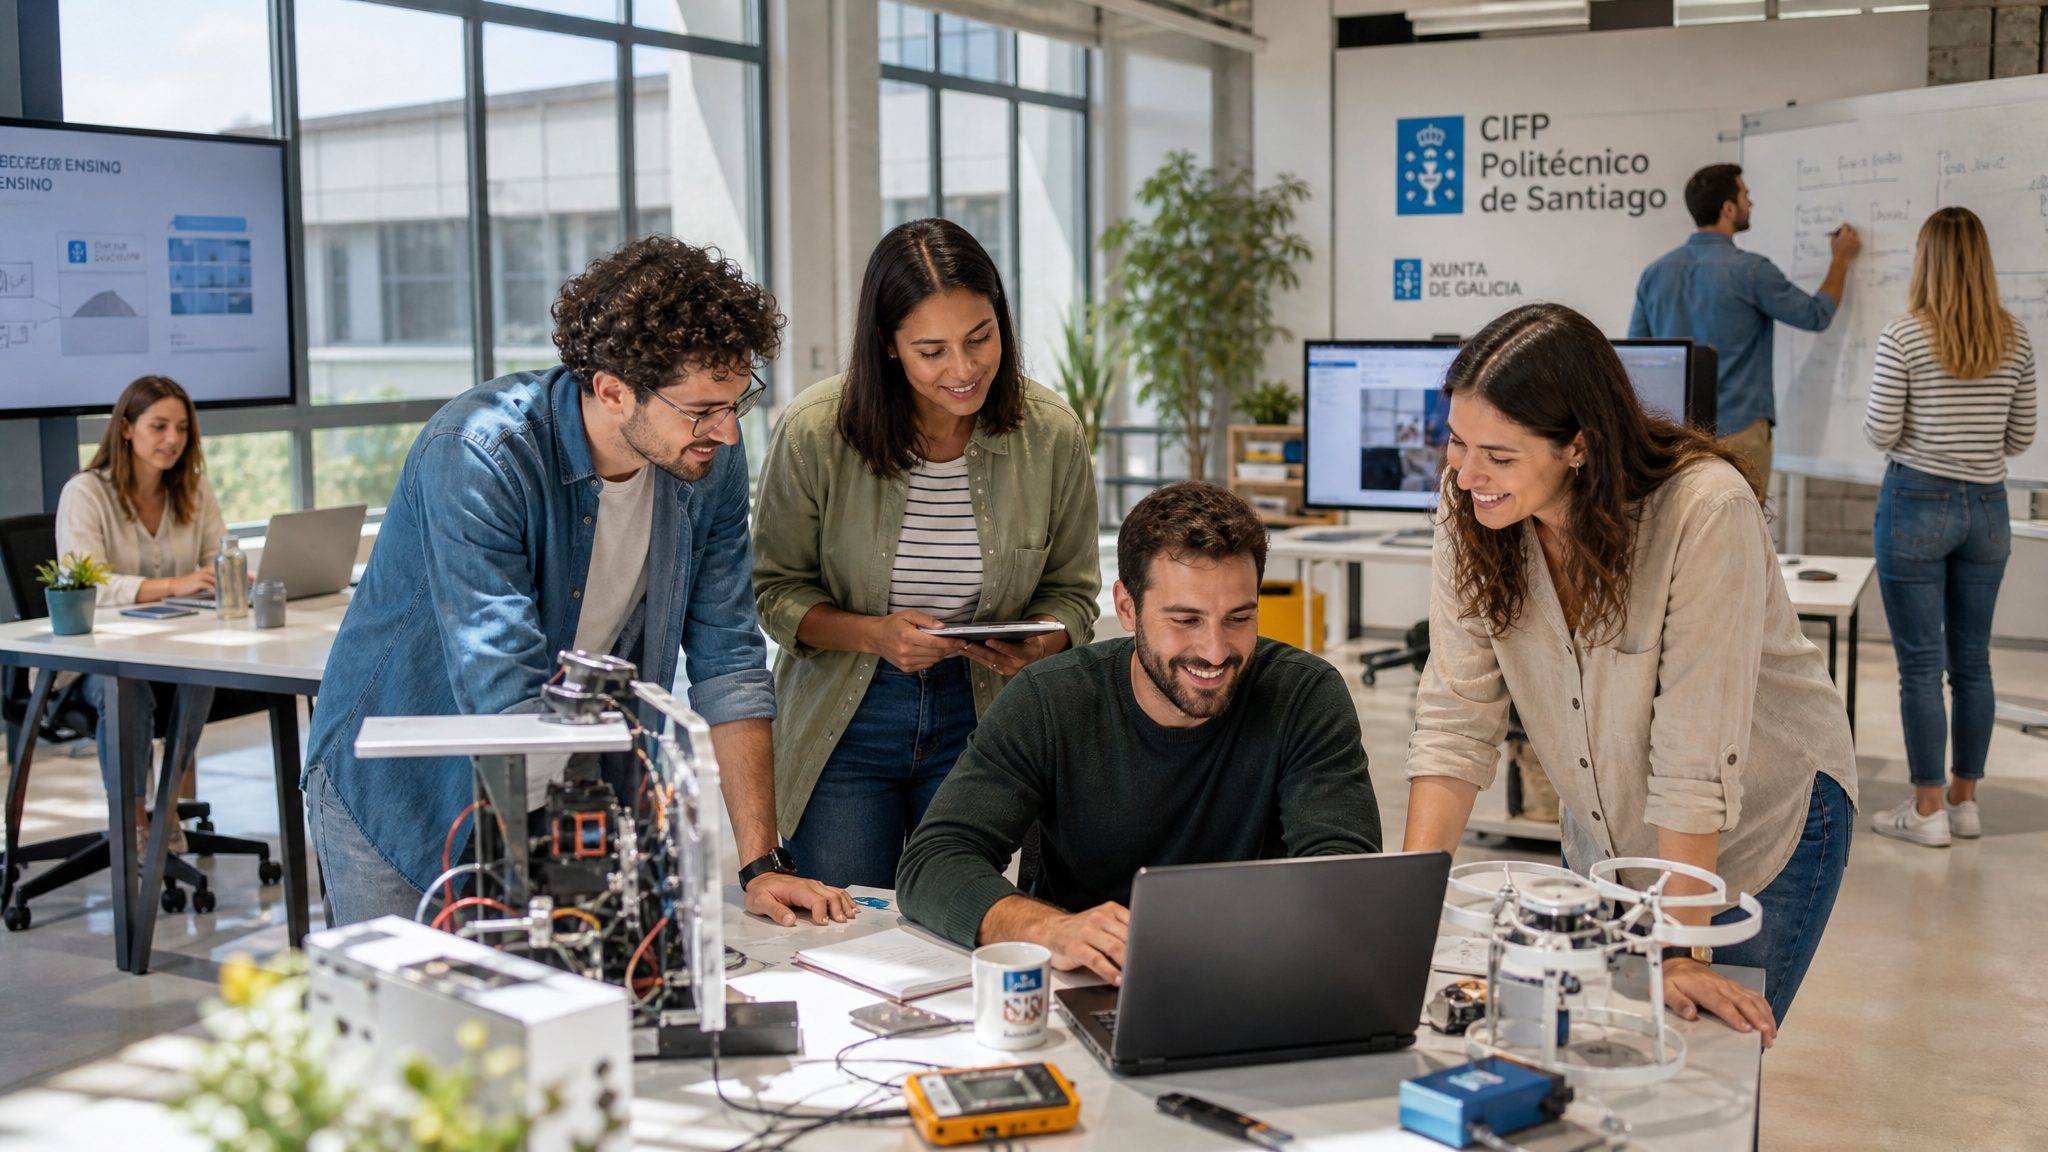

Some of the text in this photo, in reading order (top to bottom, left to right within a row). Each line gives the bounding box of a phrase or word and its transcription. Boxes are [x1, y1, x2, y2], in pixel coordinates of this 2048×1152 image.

[1480, 113, 1550, 142] CIFP
[65, 158, 121, 174] ENSINO
[1480, 148, 1650, 179] Politécnico
[1480, 184, 1667, 217] de Santiago
[1428, 262, 1488, 279] XUNTA
[1428, 280, 1522, 298] DE GALICIA
